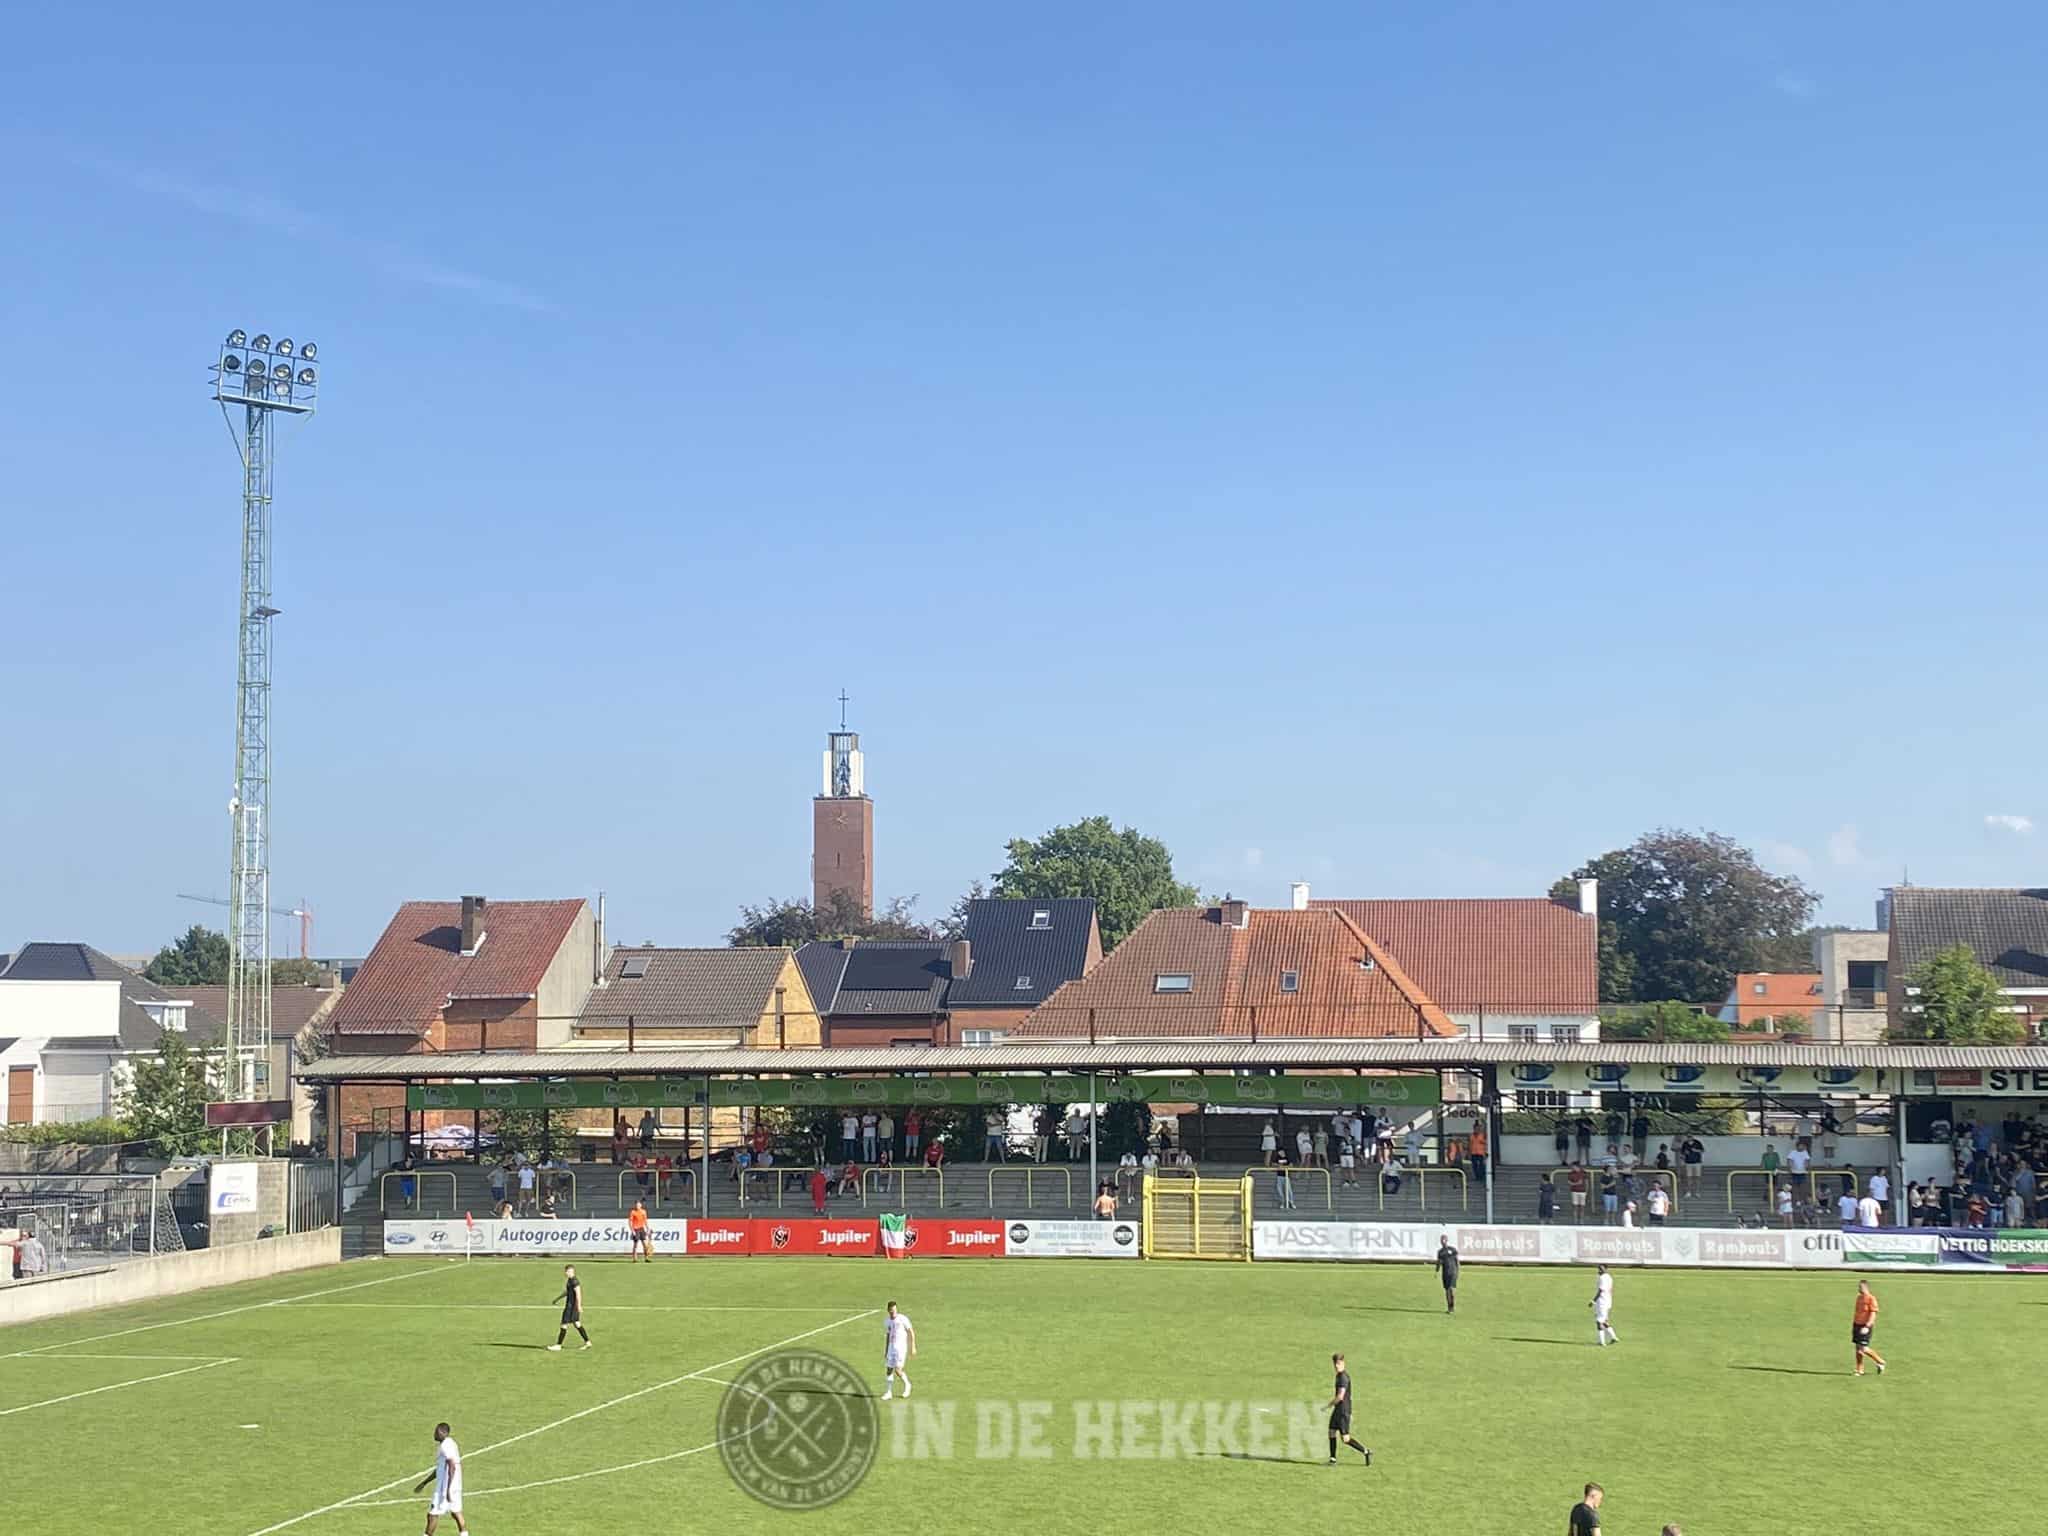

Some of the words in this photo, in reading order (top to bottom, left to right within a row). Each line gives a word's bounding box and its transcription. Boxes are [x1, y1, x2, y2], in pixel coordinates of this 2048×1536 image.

[499, 1227, 579, 1245] Autogroep
[582, 1226, 601, 1241] de
[692, 1229, 745, 1246] Jupiler
[818, 1229, 872, 1246] Jupiler
[947, 1230, 1001, 1247] Jupiler
[1349, 1227, 1419, 1249] PRINT
[1463, 1234, 1535, 1251] Rombouts
[1583, 1236, 1656, 1254] Rombouts
[1704, 1239, 1779, 1256] Rombouts
[1940, 1237, 1988, 1252] VETTIG
